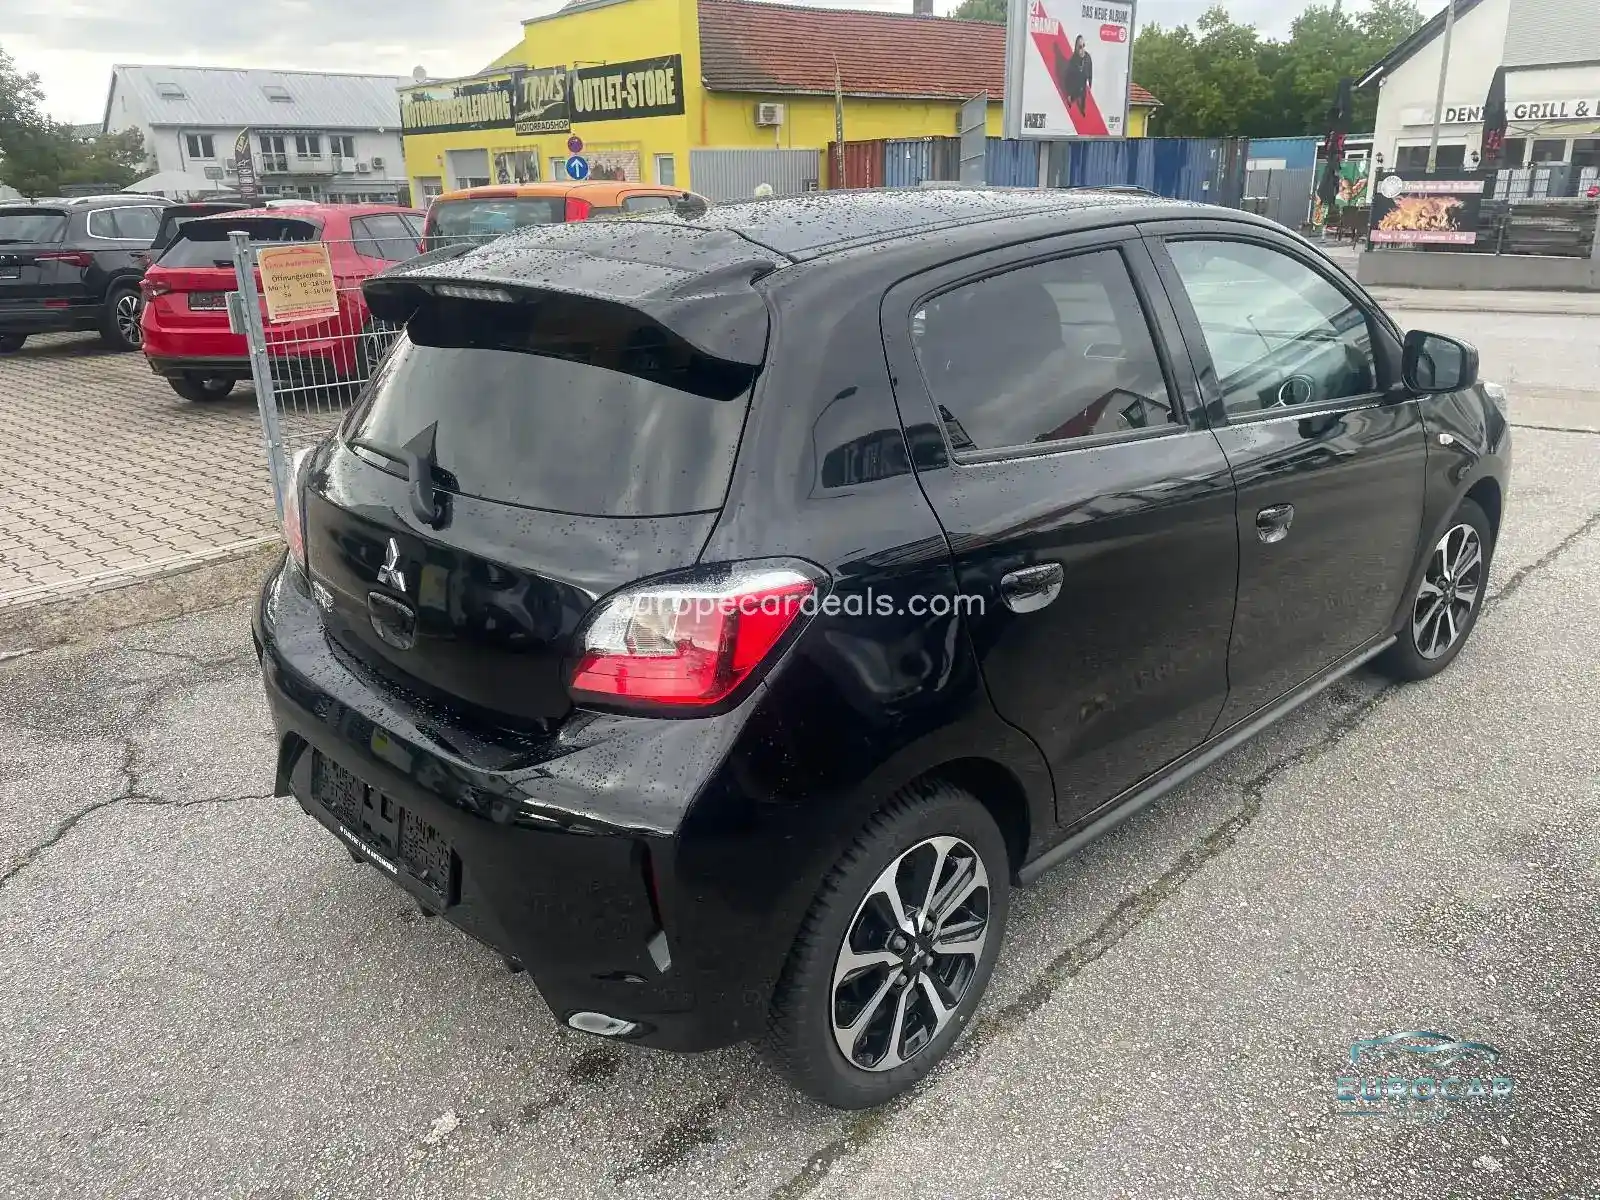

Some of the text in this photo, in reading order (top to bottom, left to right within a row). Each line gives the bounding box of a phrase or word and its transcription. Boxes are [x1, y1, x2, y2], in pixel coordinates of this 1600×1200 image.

[1081, 5, 1094, 18] DAS
[573, 66, 676, 113] OUTLET-STORE
[1515, 102, 1568, 119] GRILL
[1575, 100, 1590, 117] &
[516, 119, 569, 132] MOTORRADSHOP
